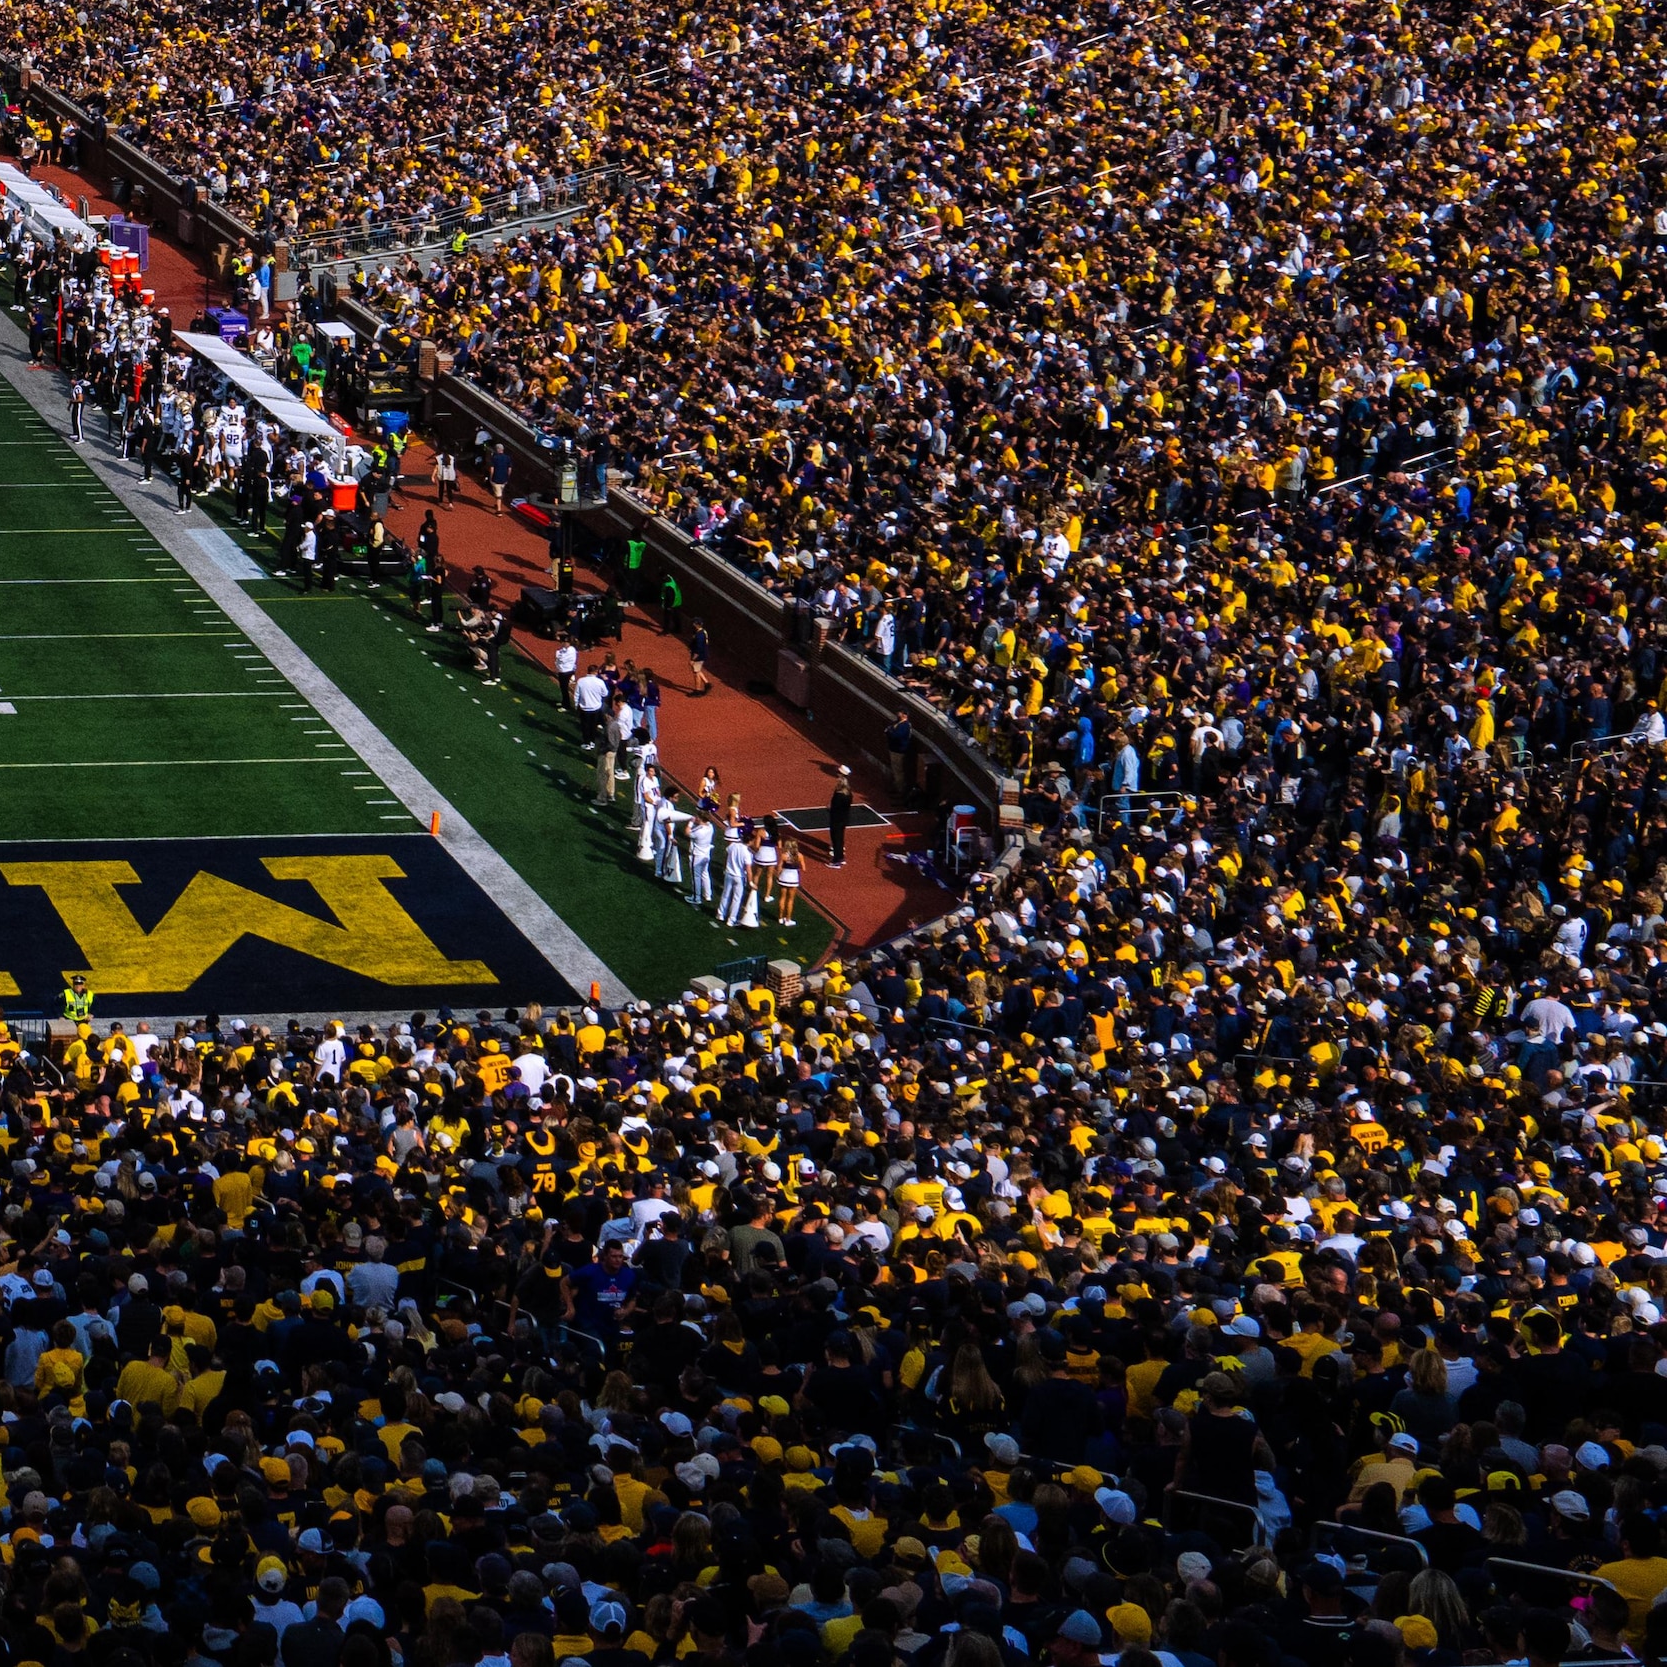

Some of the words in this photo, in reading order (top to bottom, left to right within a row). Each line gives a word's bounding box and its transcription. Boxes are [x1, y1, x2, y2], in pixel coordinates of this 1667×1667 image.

[306, 387, 315, 396] M
[226, 434, 239, 444] 92
[494, 1068, 509, 1083] 19
[532, 1172, 555, 1193] 78
